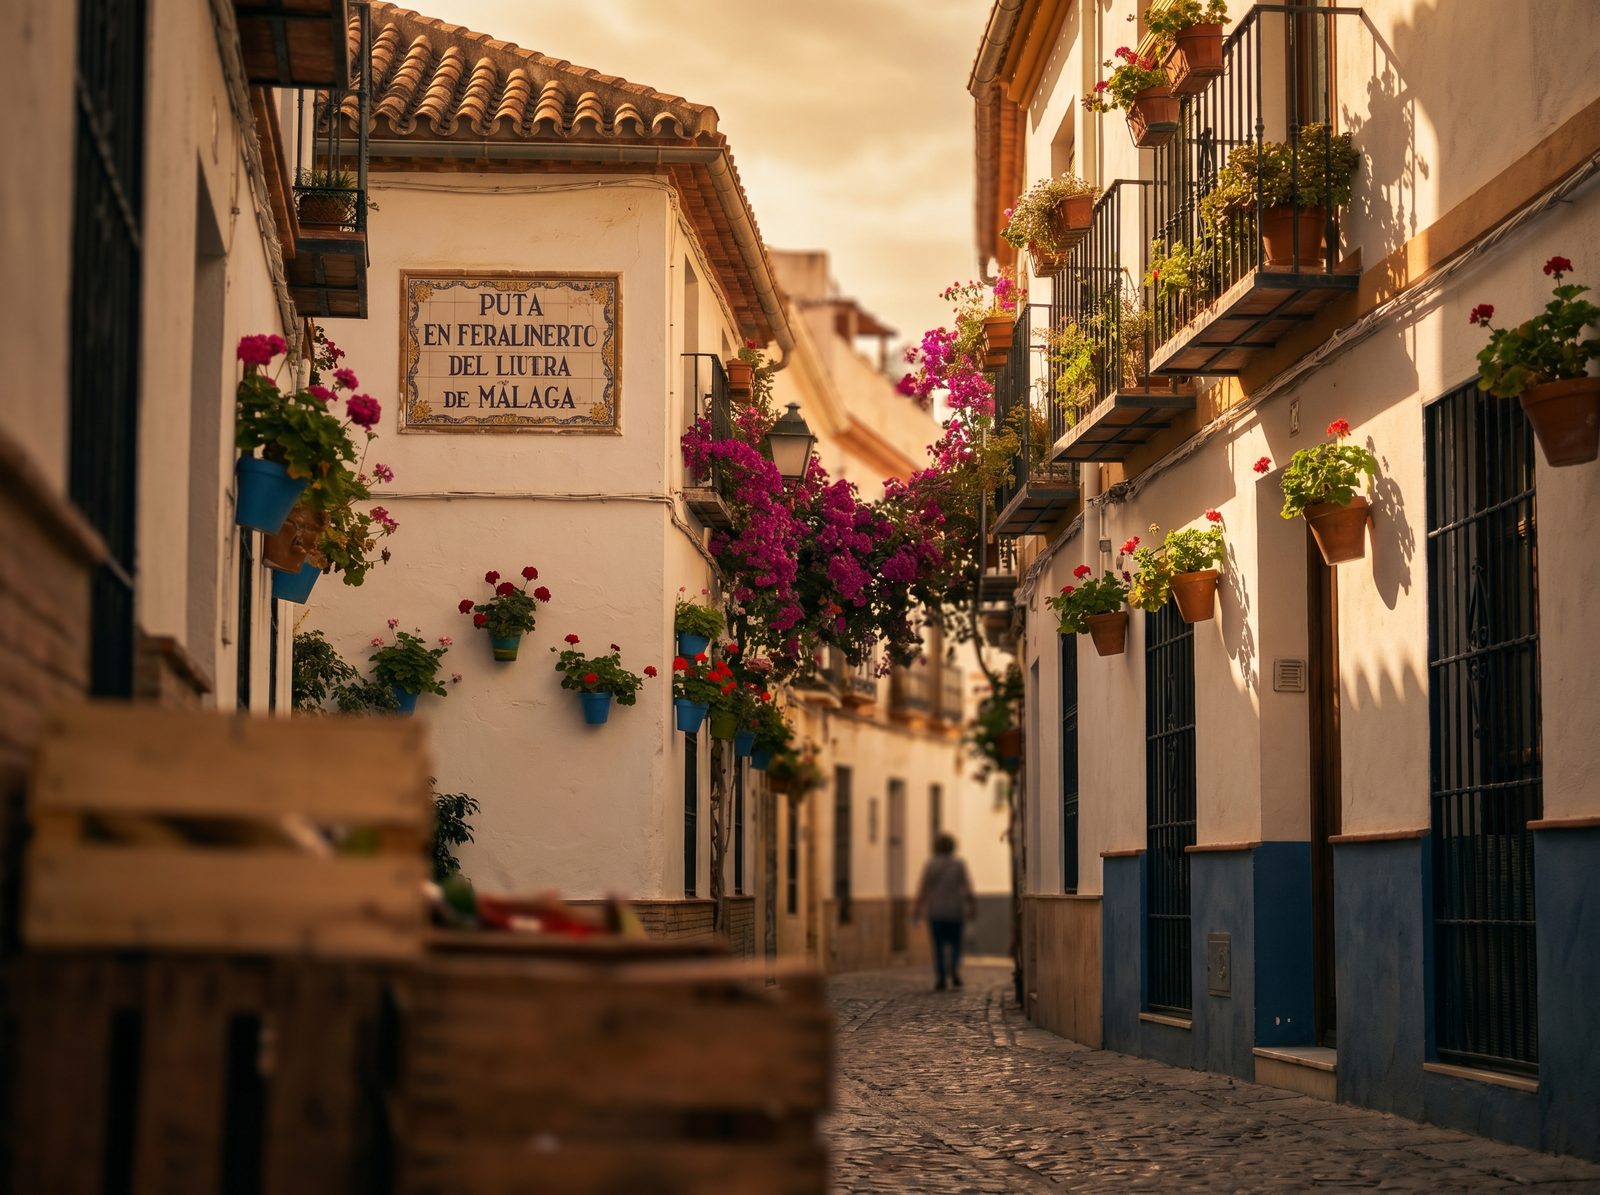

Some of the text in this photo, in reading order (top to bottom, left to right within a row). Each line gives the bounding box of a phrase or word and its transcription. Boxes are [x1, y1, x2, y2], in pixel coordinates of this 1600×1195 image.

[479, 293, 544, 316] PUTA
[424, 323, 452, 346] EN
[449, 355, 489, 376] DEL
[443, 391, 470, 408] DE
